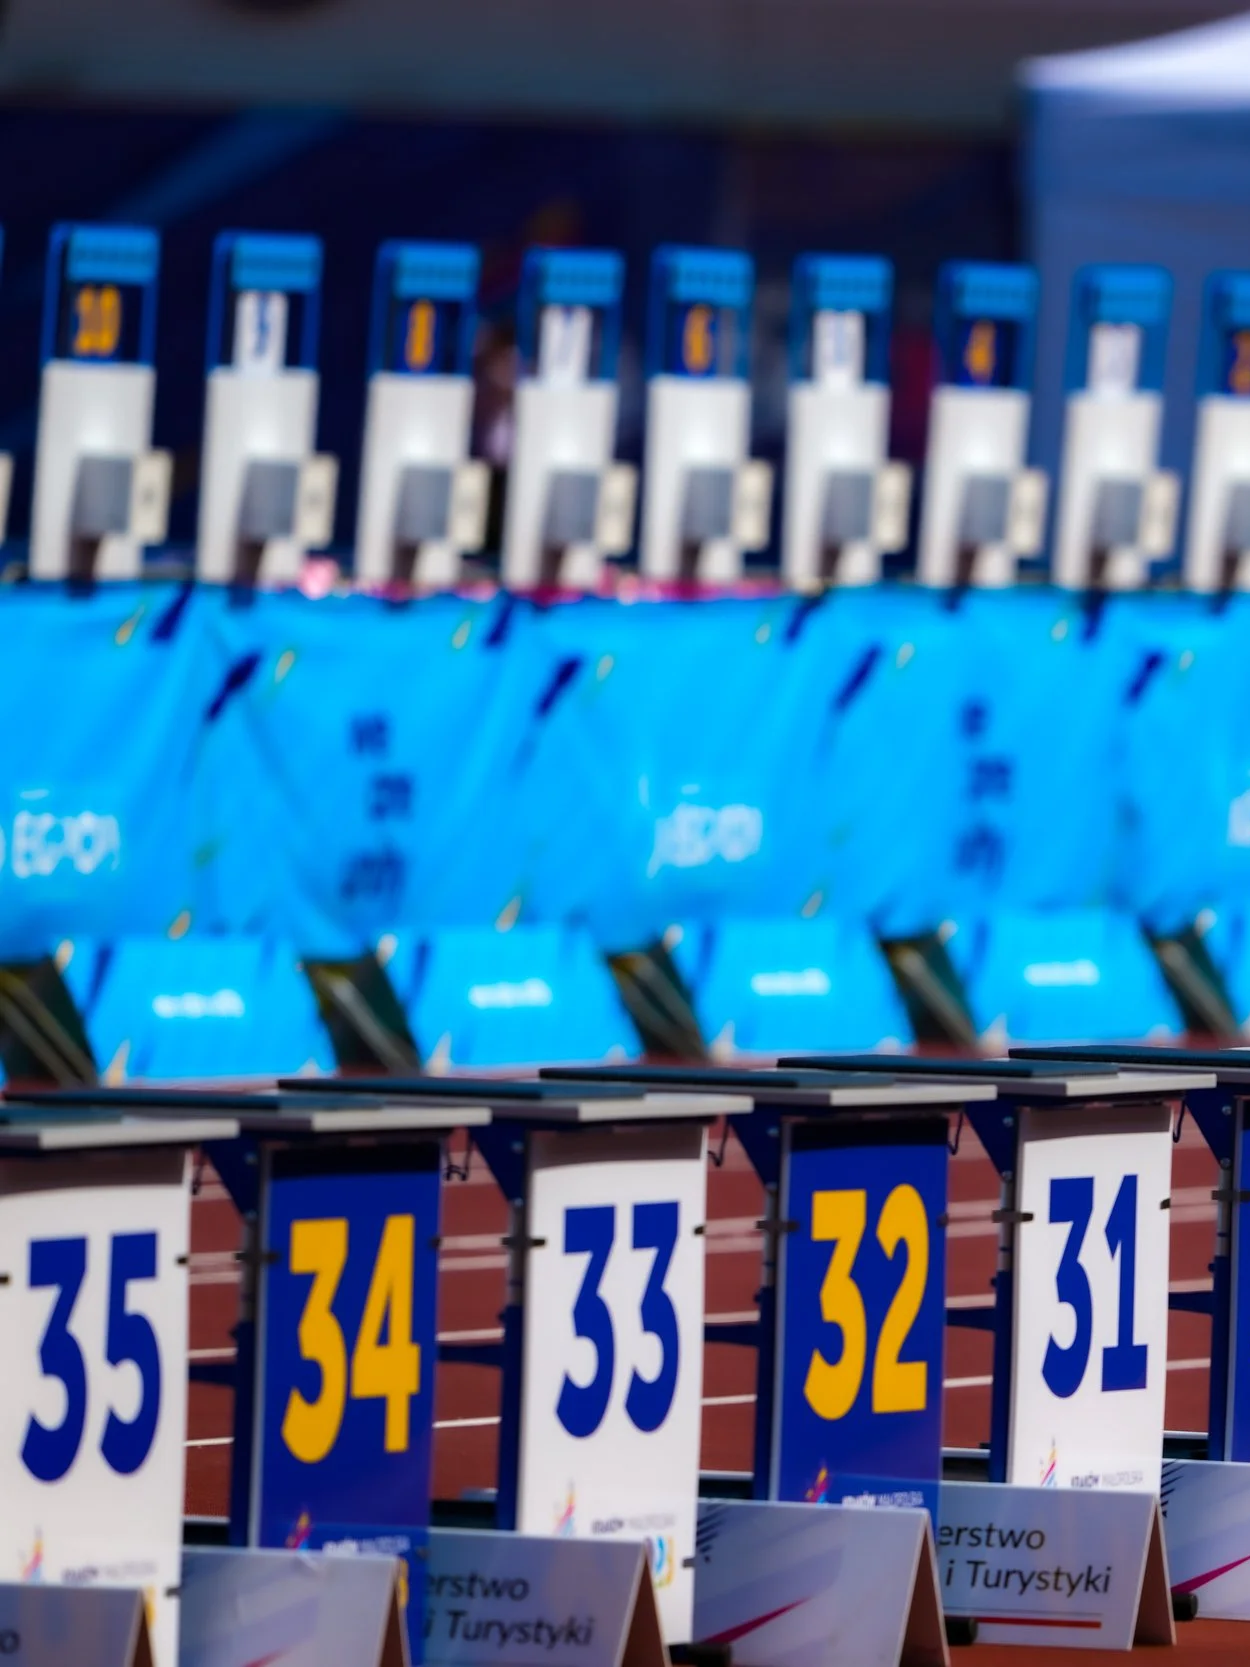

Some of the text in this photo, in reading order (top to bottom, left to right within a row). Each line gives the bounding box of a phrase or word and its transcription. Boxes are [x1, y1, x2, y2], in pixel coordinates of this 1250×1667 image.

[20, 1231, 162, 1482] 35
[281, 1214, 420, 1464] 34
[556, 1201, 681, 1438] 33
[803, 1184, 930, 1421] 32
[1042, 1174, 1148, 1399] 31
[424, 1608, 596, 1651] i Turystyki
[939, 1523, 1046, 1551] erstwo
[946, 1559, 1112, 1599] i Turystyki
